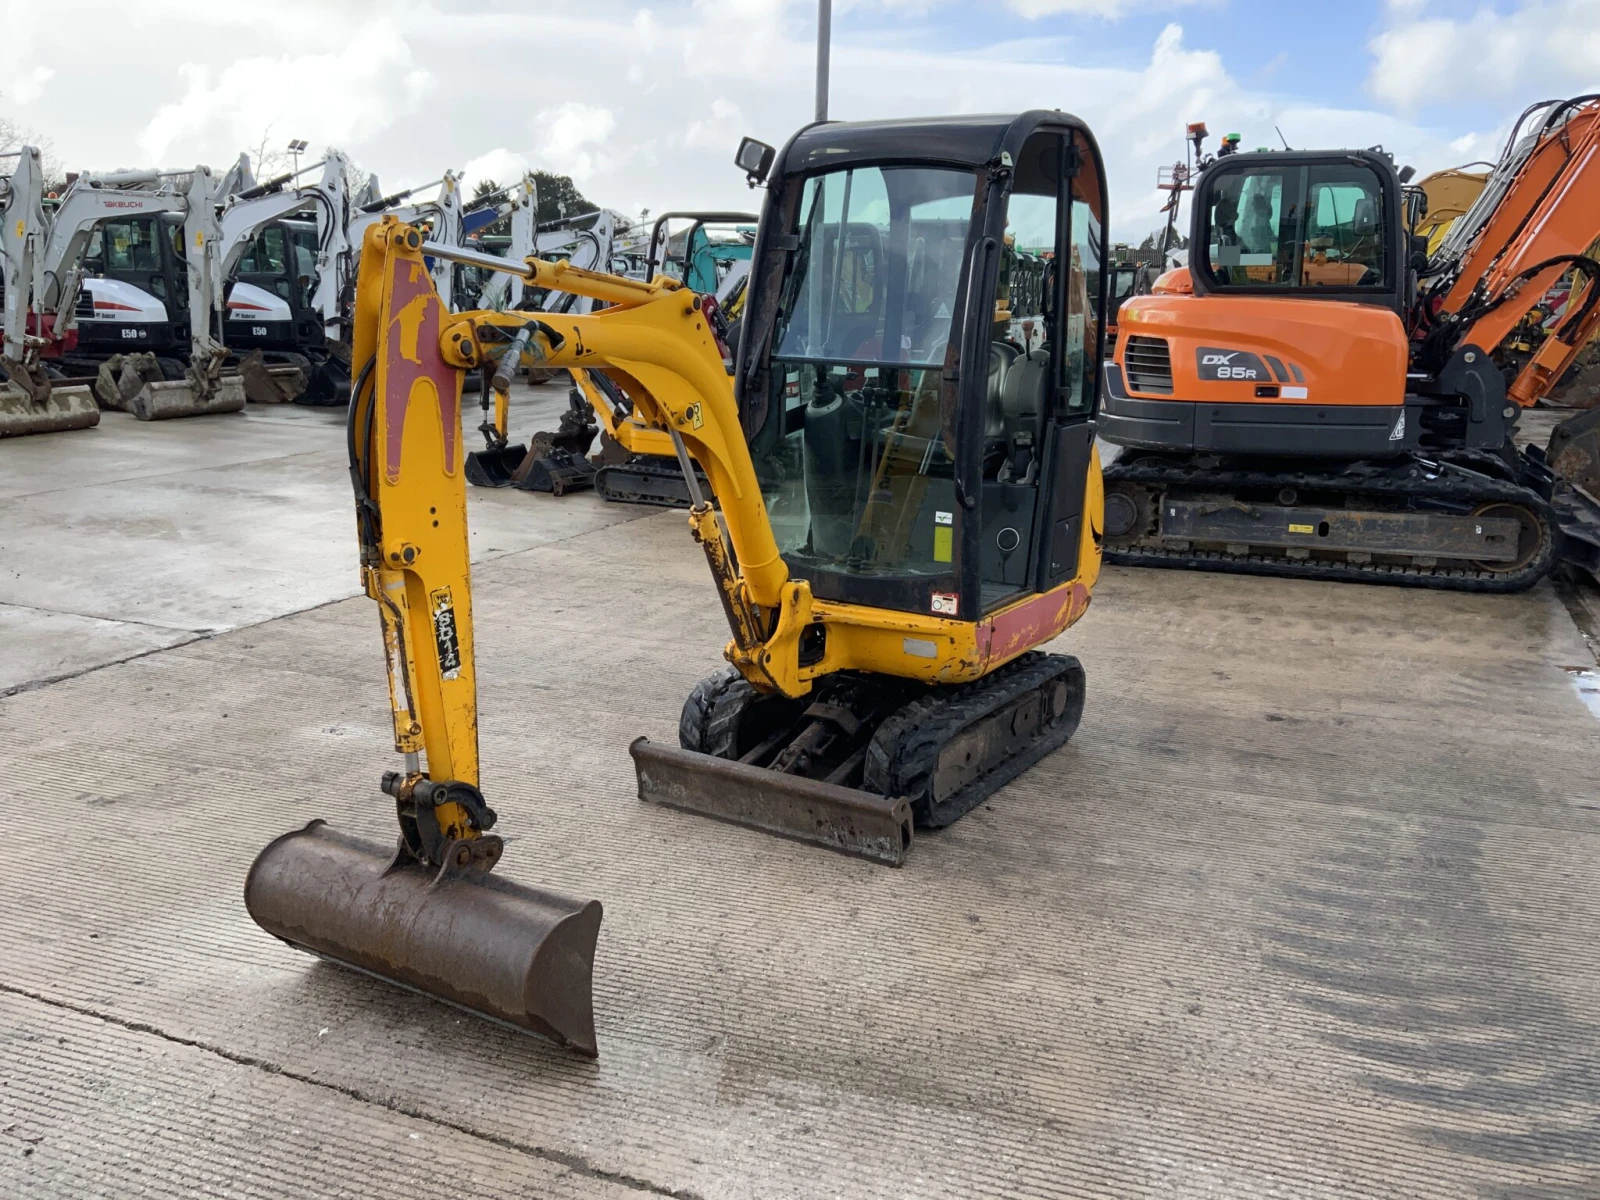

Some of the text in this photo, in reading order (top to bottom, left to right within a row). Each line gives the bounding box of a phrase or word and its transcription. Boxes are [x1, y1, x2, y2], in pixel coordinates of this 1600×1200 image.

[122, 329, 137, 338] E50
[253, 327, 267, 336] E50
[1202, 352, 1239, 365] DX
[1217, 366, 1257, 378] 85R
[438, 612, 456, 667] 8014
